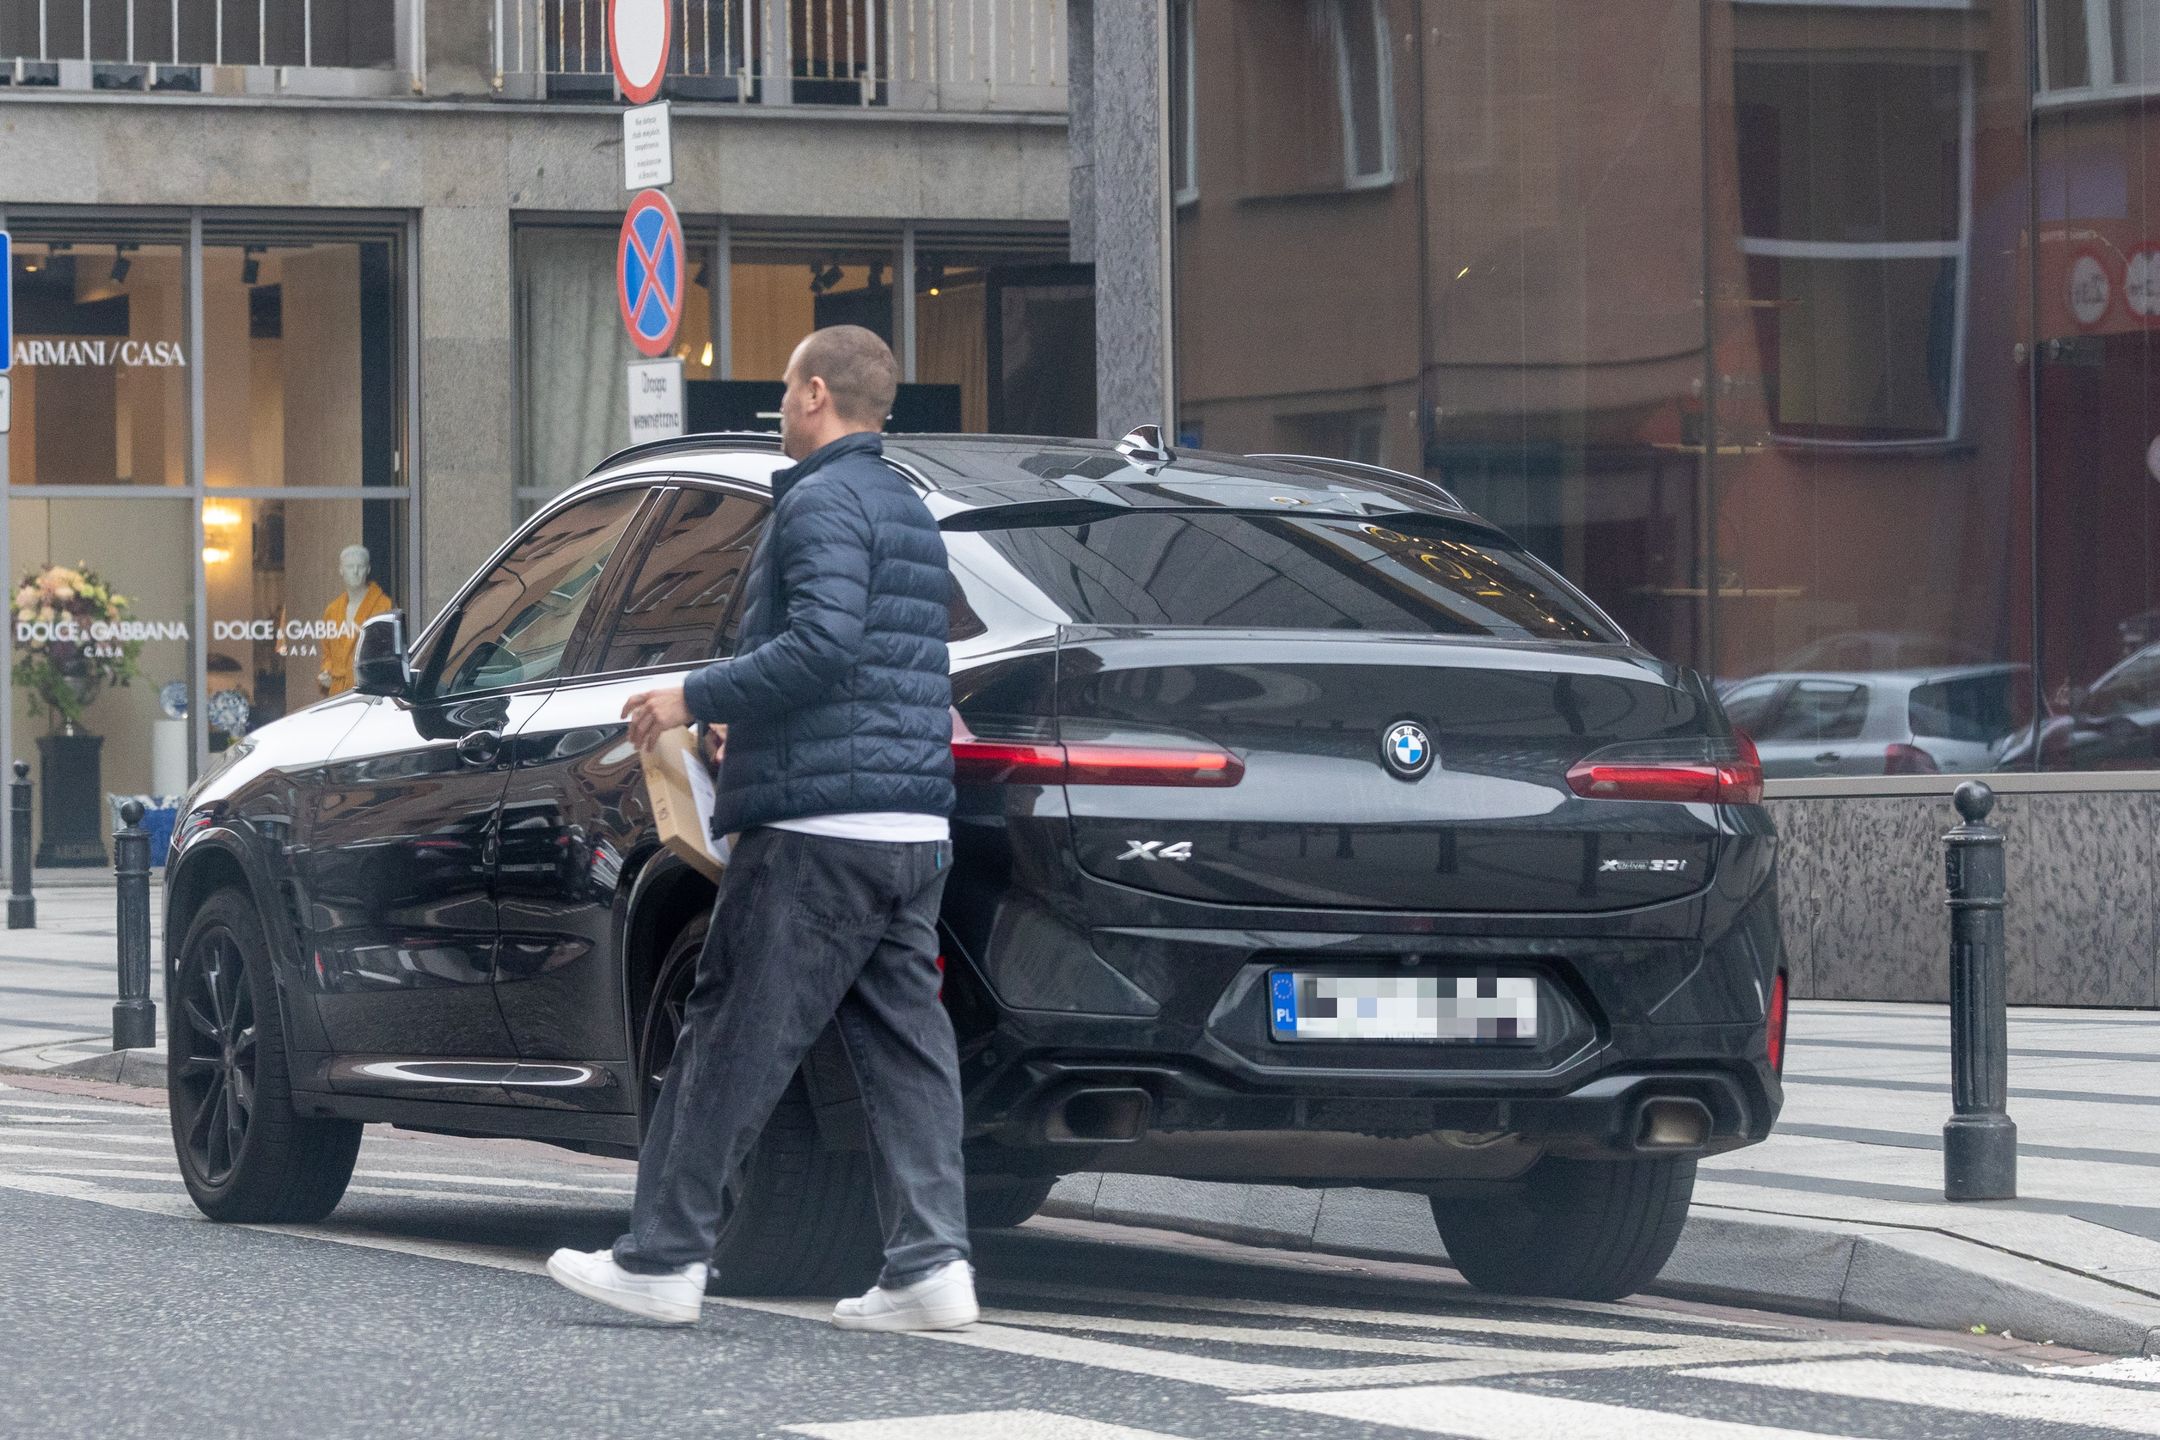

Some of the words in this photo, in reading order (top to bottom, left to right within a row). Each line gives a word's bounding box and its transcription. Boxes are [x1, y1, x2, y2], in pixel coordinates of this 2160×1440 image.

[641, 371, 667, 399] Droga
[285, 619, 361, 640] GABBAN
[83, 645, 125, 658] CASA
[279, 645, 318, 657] CASA
[1115, 839, 1194, 861] X4
[1276, 1008, 1294, 1023] PL
